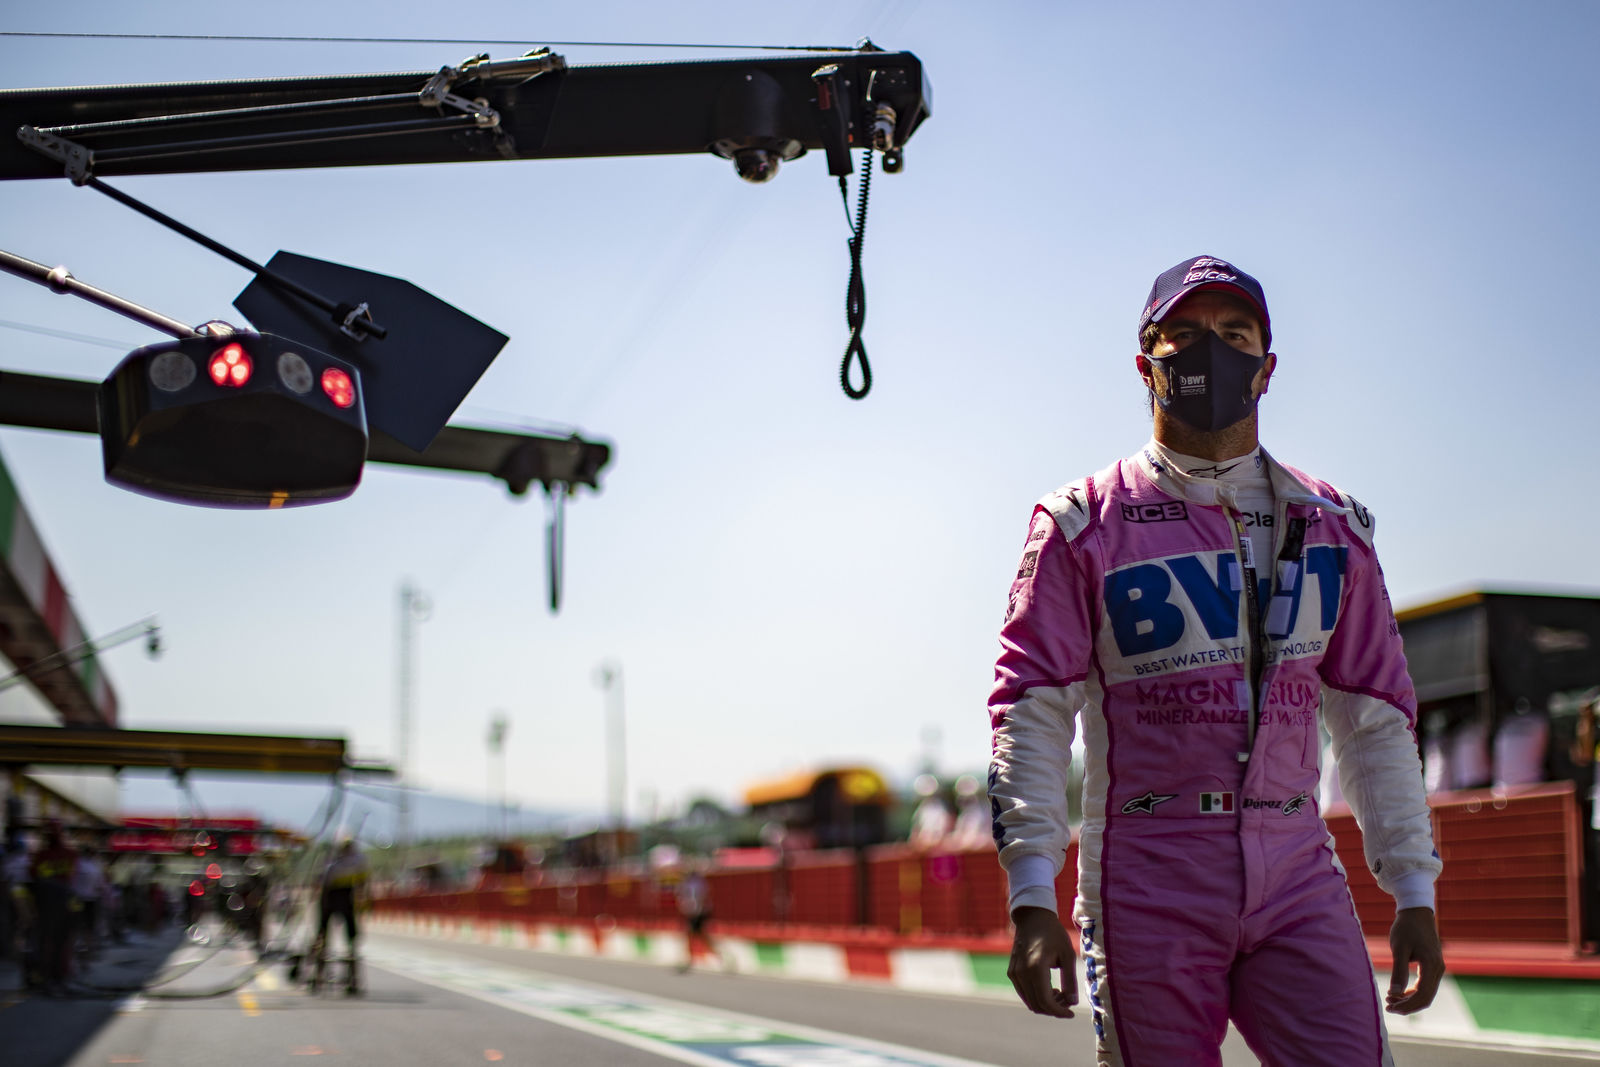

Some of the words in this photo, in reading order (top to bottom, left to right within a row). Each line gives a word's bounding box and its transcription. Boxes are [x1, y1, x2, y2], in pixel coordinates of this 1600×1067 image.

[1187, 375, 1206, 385] BWT
[1124, 502, 1186, 521] JCB
[1241, 511, 1274, 527] Cla
[1104, 546, 1348, 657] BWT
[1133, 658, 1168, 675] BEST
[1171, 649, 1229, 668] WATER
[1136, 680, 1319, 709] MAGNSIUM
